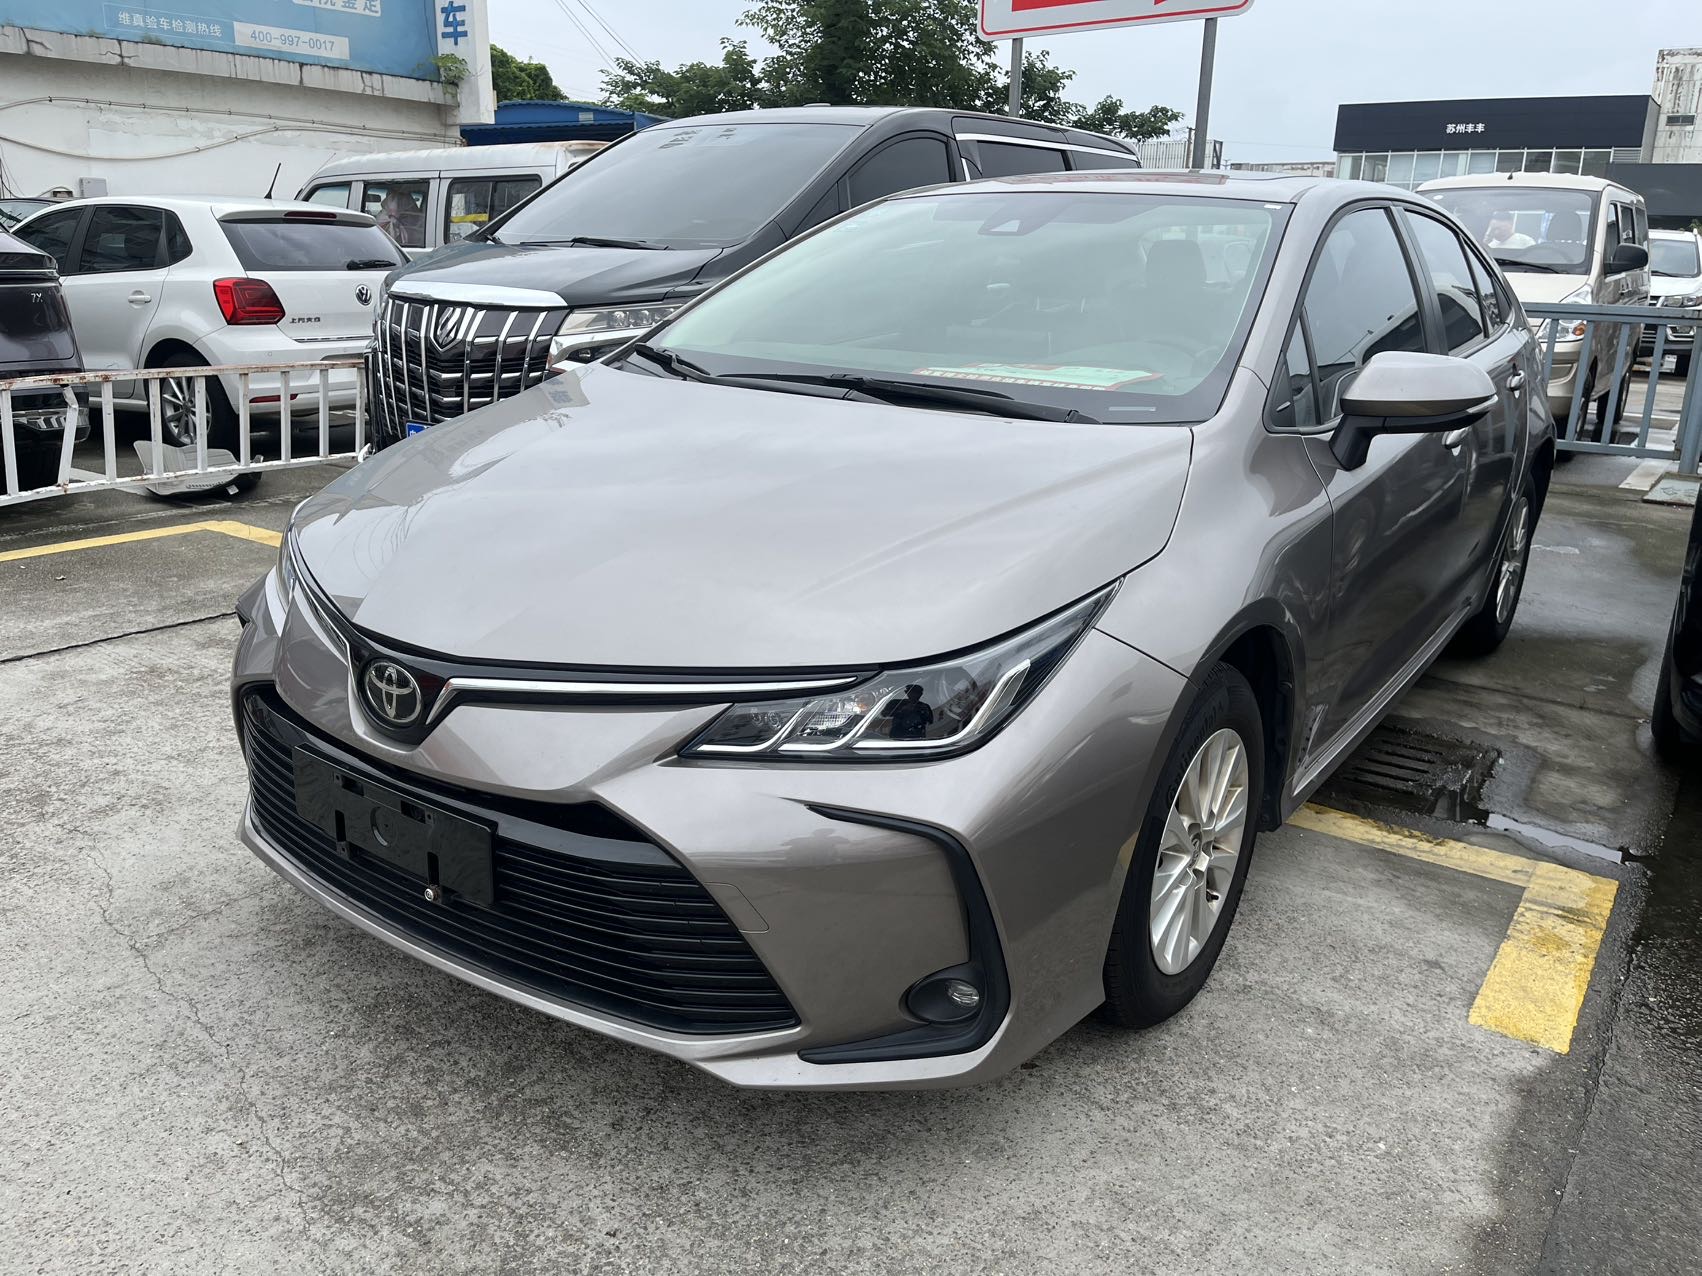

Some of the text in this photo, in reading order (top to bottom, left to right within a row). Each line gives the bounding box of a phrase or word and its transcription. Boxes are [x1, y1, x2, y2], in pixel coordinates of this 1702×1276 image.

[118, 11, 222, 37] 维真验车检测热线
[441, 0, 468, 46] 车
[250, 29, 335, 51] 400-997-0017
[1446, 123, 1486, 134] 苏州丰丰
